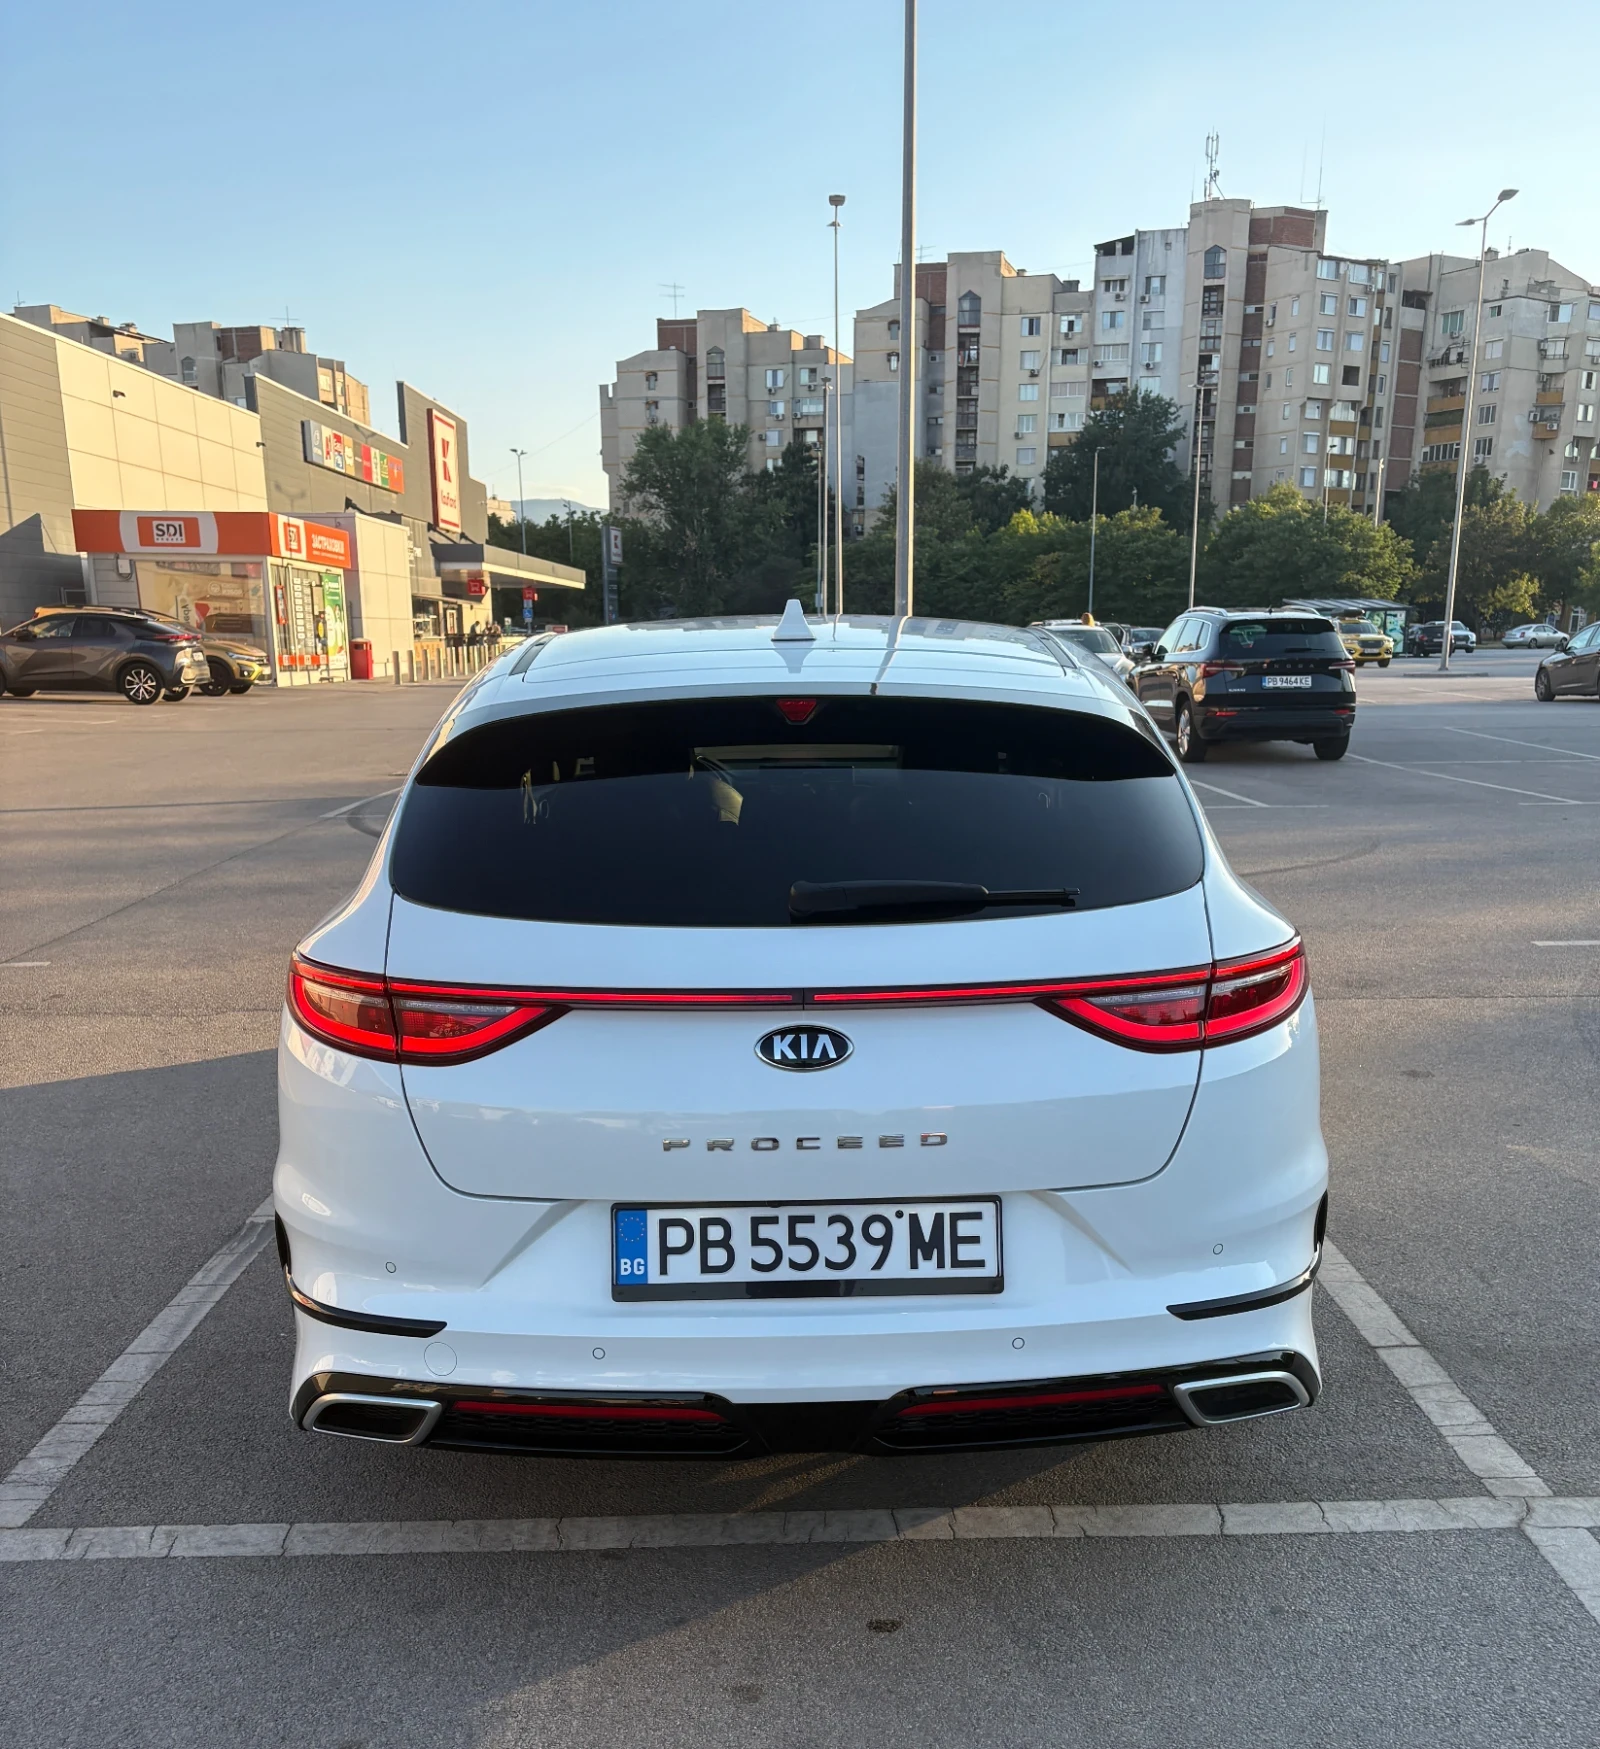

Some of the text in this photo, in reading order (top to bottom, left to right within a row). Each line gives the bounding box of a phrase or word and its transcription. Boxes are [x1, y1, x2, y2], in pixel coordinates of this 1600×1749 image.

[441, 437, 452, 483] K
[155, 523, 183, 537] SDI
[1279, 677, 1299, 686] 9464
[1299, 677, 1310, 686] KE
[773, 1034, 837, 1060] KIA
[662, 1131, 948, 1152] PROCEED
[658, 1211, 986, 1276] PB 5539 ME
[620, 1258, 646, 1276] BG
